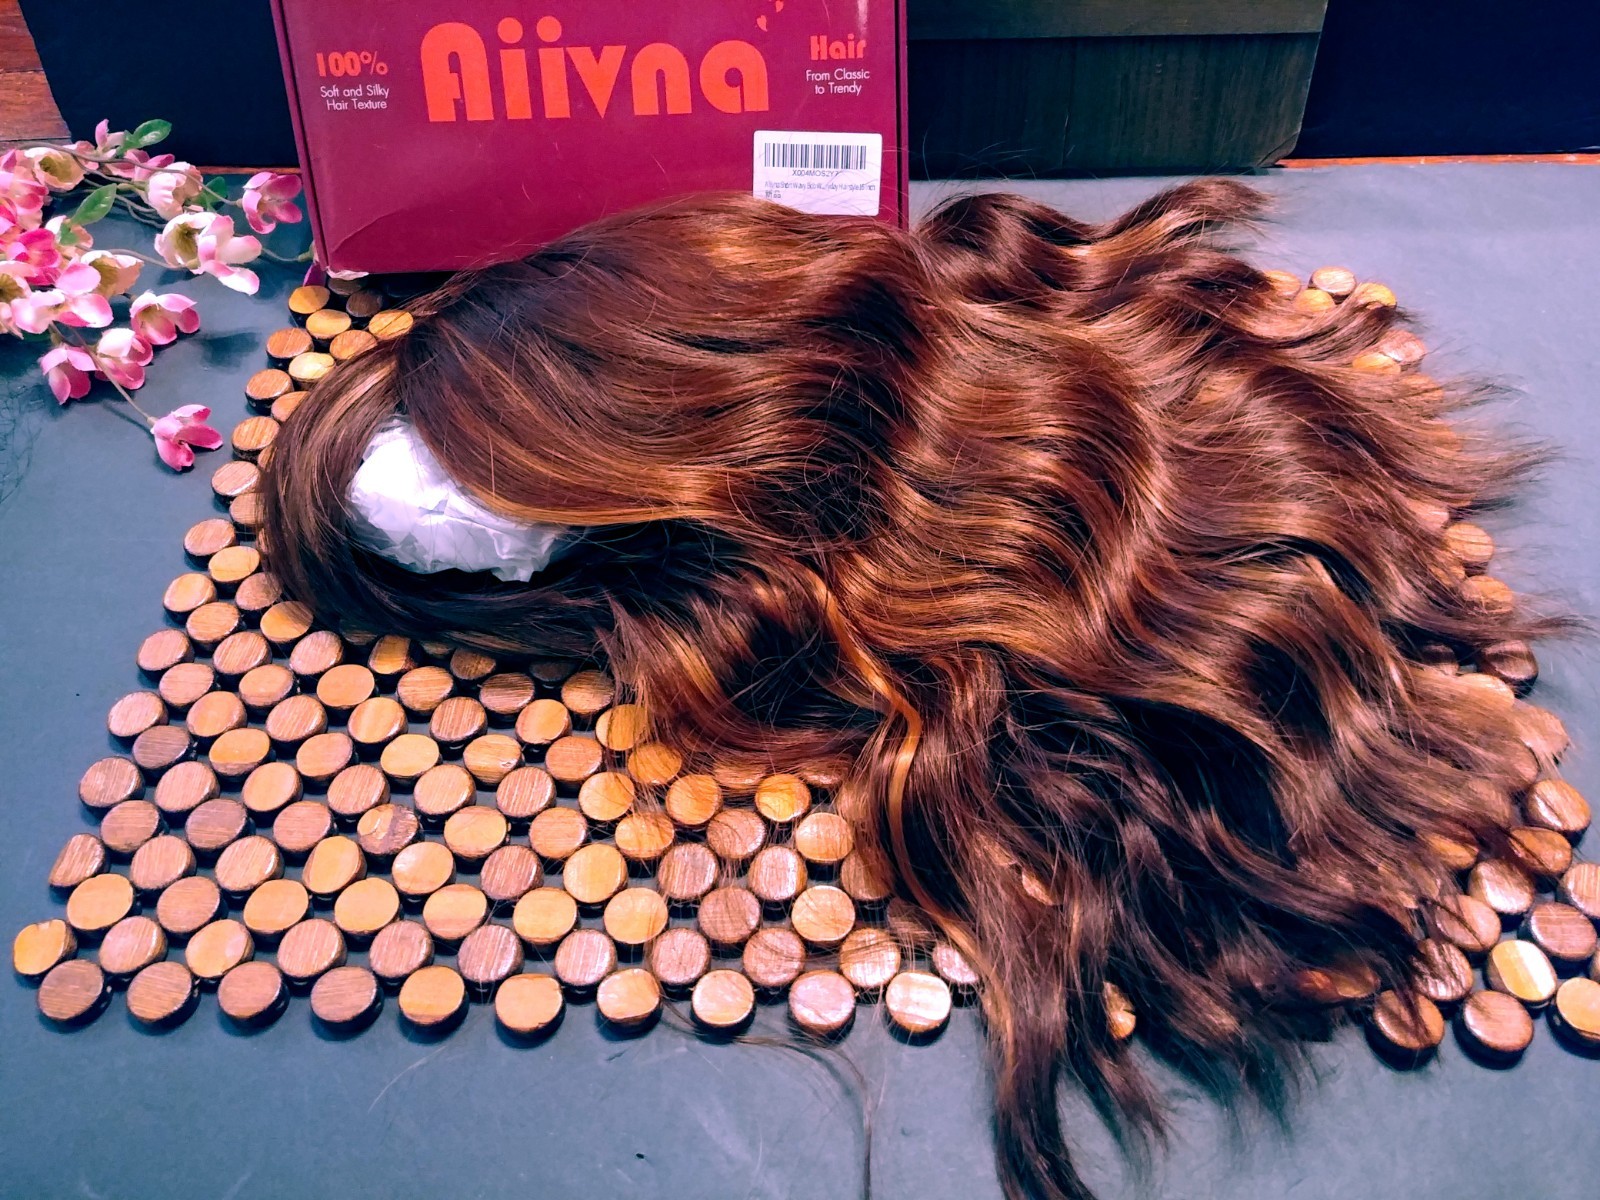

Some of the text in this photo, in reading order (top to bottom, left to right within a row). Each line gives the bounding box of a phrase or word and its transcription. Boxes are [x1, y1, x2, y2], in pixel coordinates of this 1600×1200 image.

[810, 33, 867, 61] Hair
[316, 51, 389, 77] 100%
[420, 16, 769, 122] Aiivna
[805, 67, 871, 82] From Classic
[320, 83, 390, 99] Soft and Silky
[814, 80, 862, 97] to Trendy
[326, 98, 388, 111] Hair Texture
